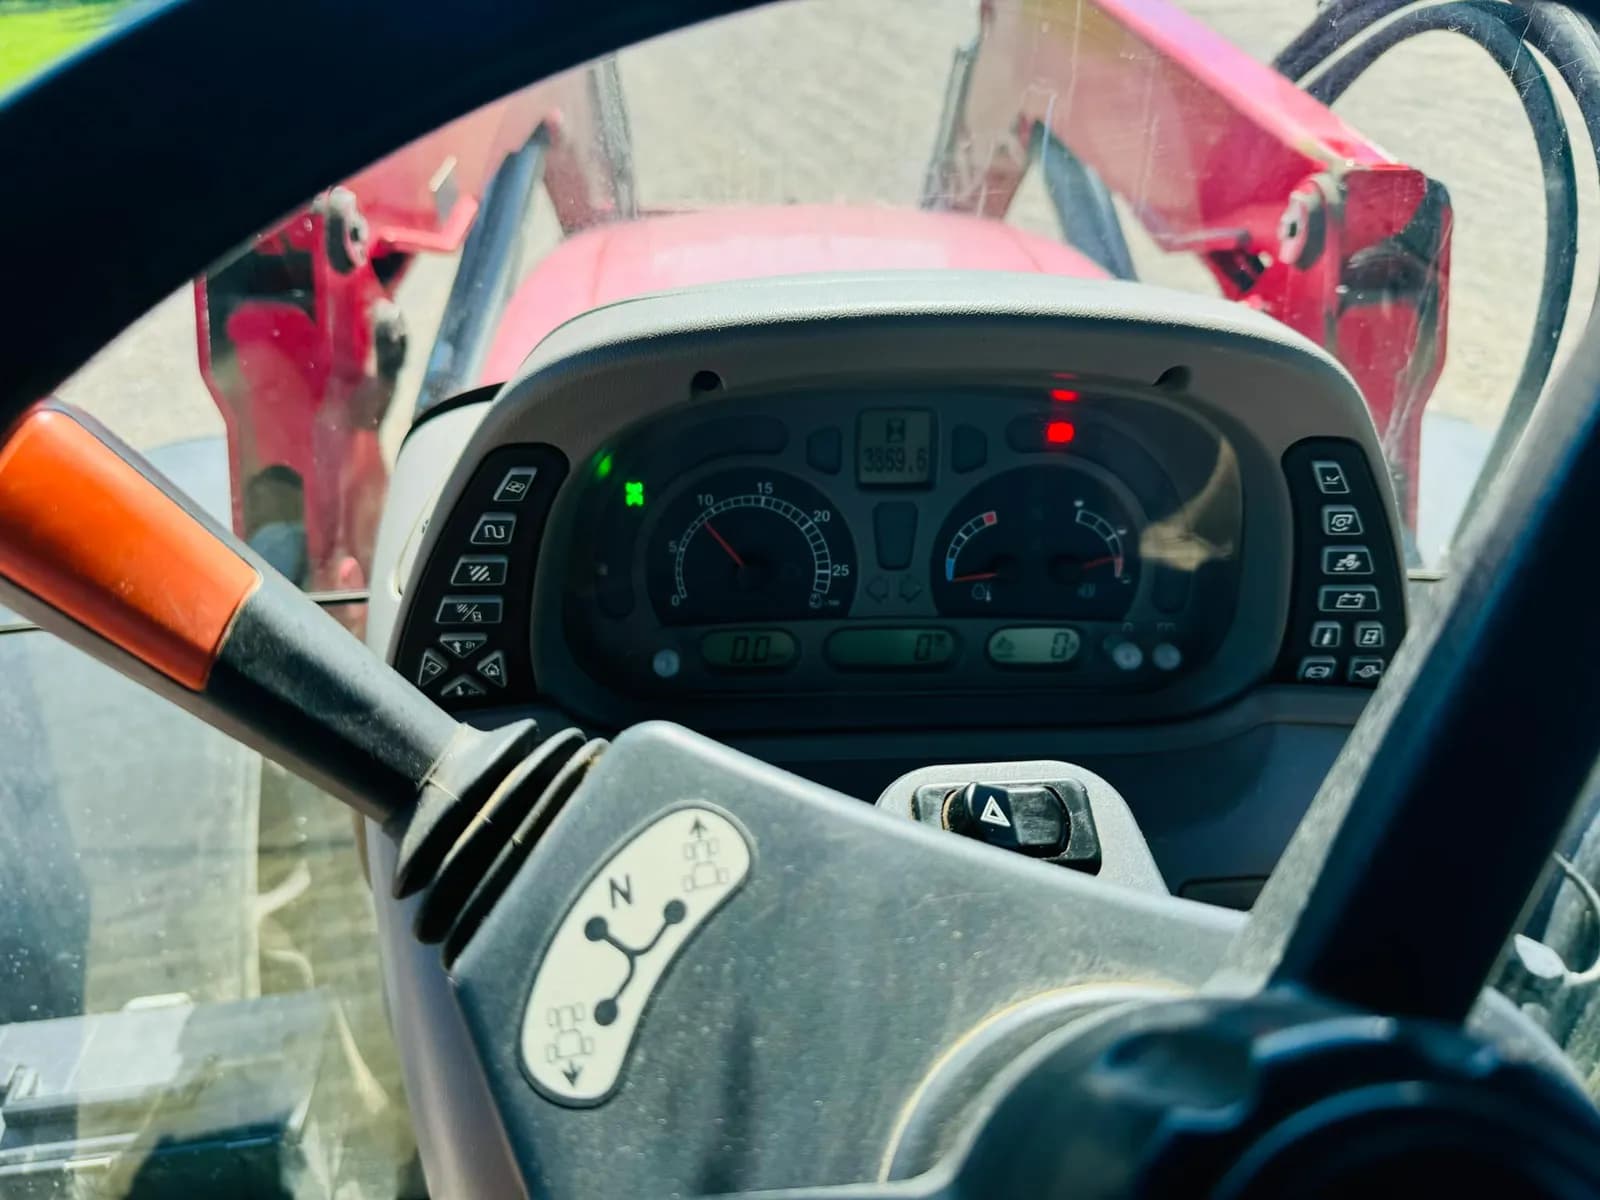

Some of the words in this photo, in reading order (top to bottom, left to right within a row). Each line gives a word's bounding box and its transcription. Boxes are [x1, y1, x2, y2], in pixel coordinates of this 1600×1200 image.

[756, 481, 774, 494] 15
[696, 493, 714, 506] 10
[813, 509, 831, 523] 20
[668, 540, 678, 553] 5
[832, 564, 850, 577] 25
[671, 594, 680, 607] 0
[914, 634, 932, 661] 0
[609, 873, 632, 909] N
